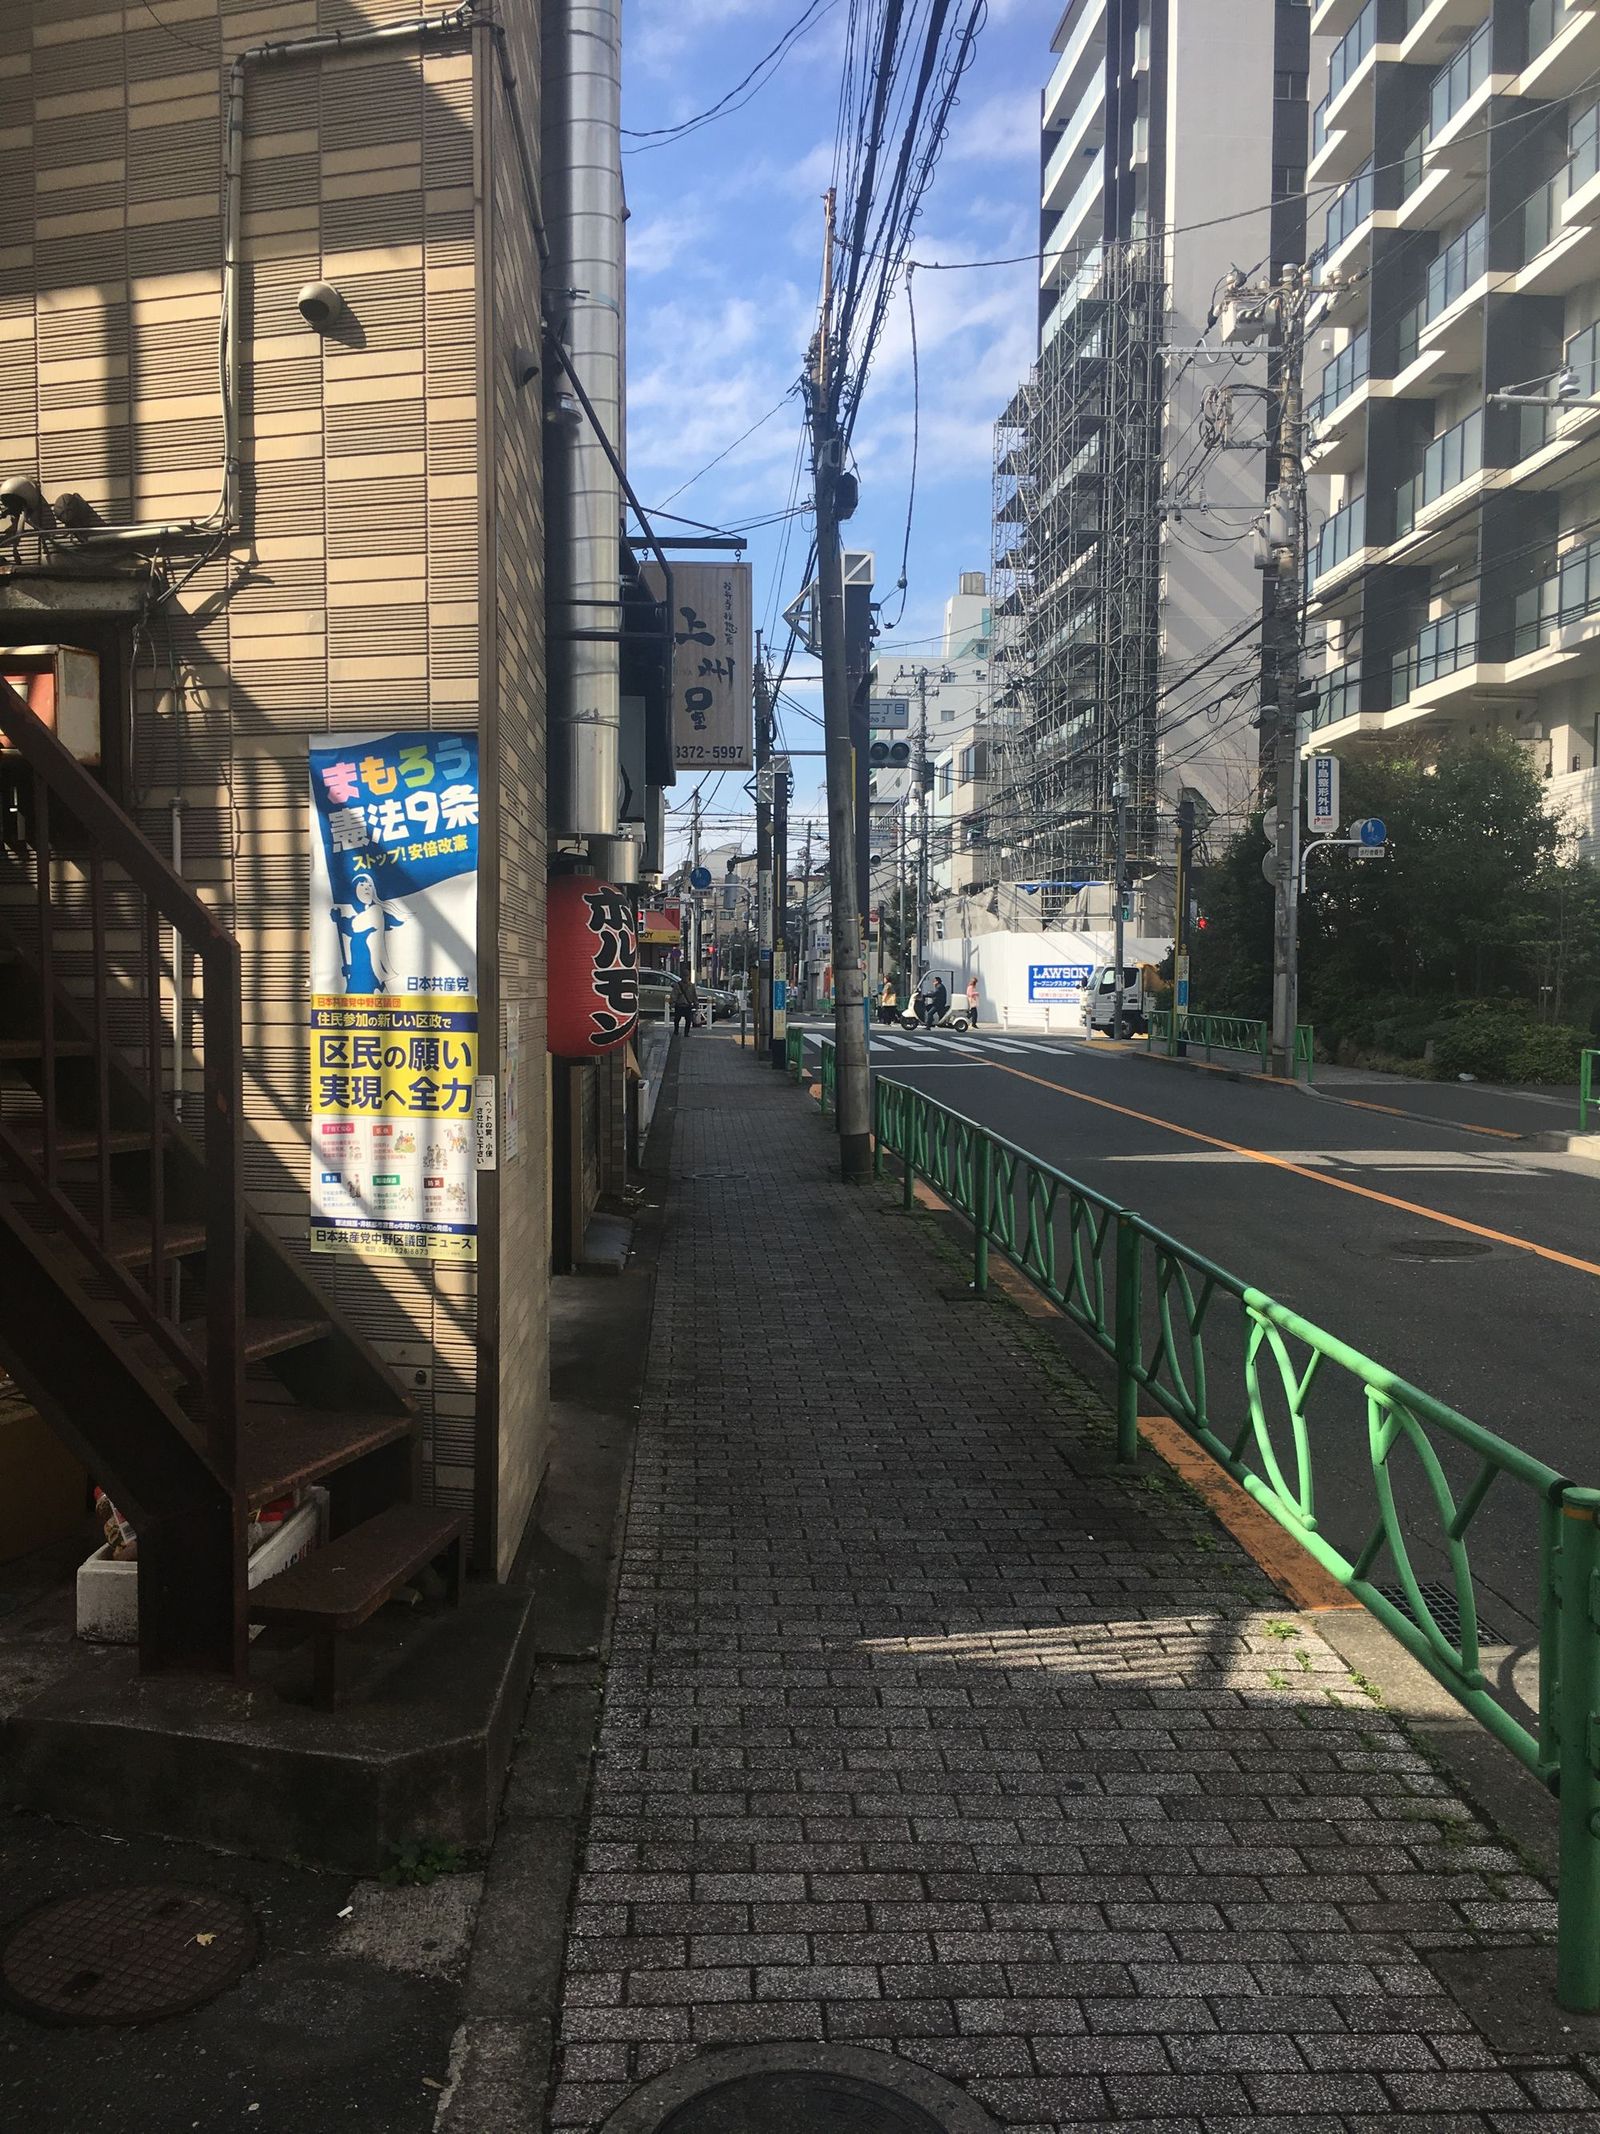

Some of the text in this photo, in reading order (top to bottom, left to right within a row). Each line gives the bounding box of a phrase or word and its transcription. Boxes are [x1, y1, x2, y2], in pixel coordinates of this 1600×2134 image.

[322, 738, 473, 804] まもろう
[1317, 759, 1330, 815] 中島整形外科
[328, 784, 479, 853] 憲法9条
[407, 976, 469, 992] 日本共産党
[1033, 967, 1090, 979] LAWSON
[317, 997, 401, 1008] 日本共産党中野区議団
[317, 1012, 452, 1029] 住民参加の新しい区政で
[319, 1036, 473, 1072] 区民の願い
[319, 1074, 472, 1113] 実現へ全力
[476, 1107, 484, 1165] させないで下さい
[316, 1230, 473, 1249] 日本共産党中野区議団ニュース
